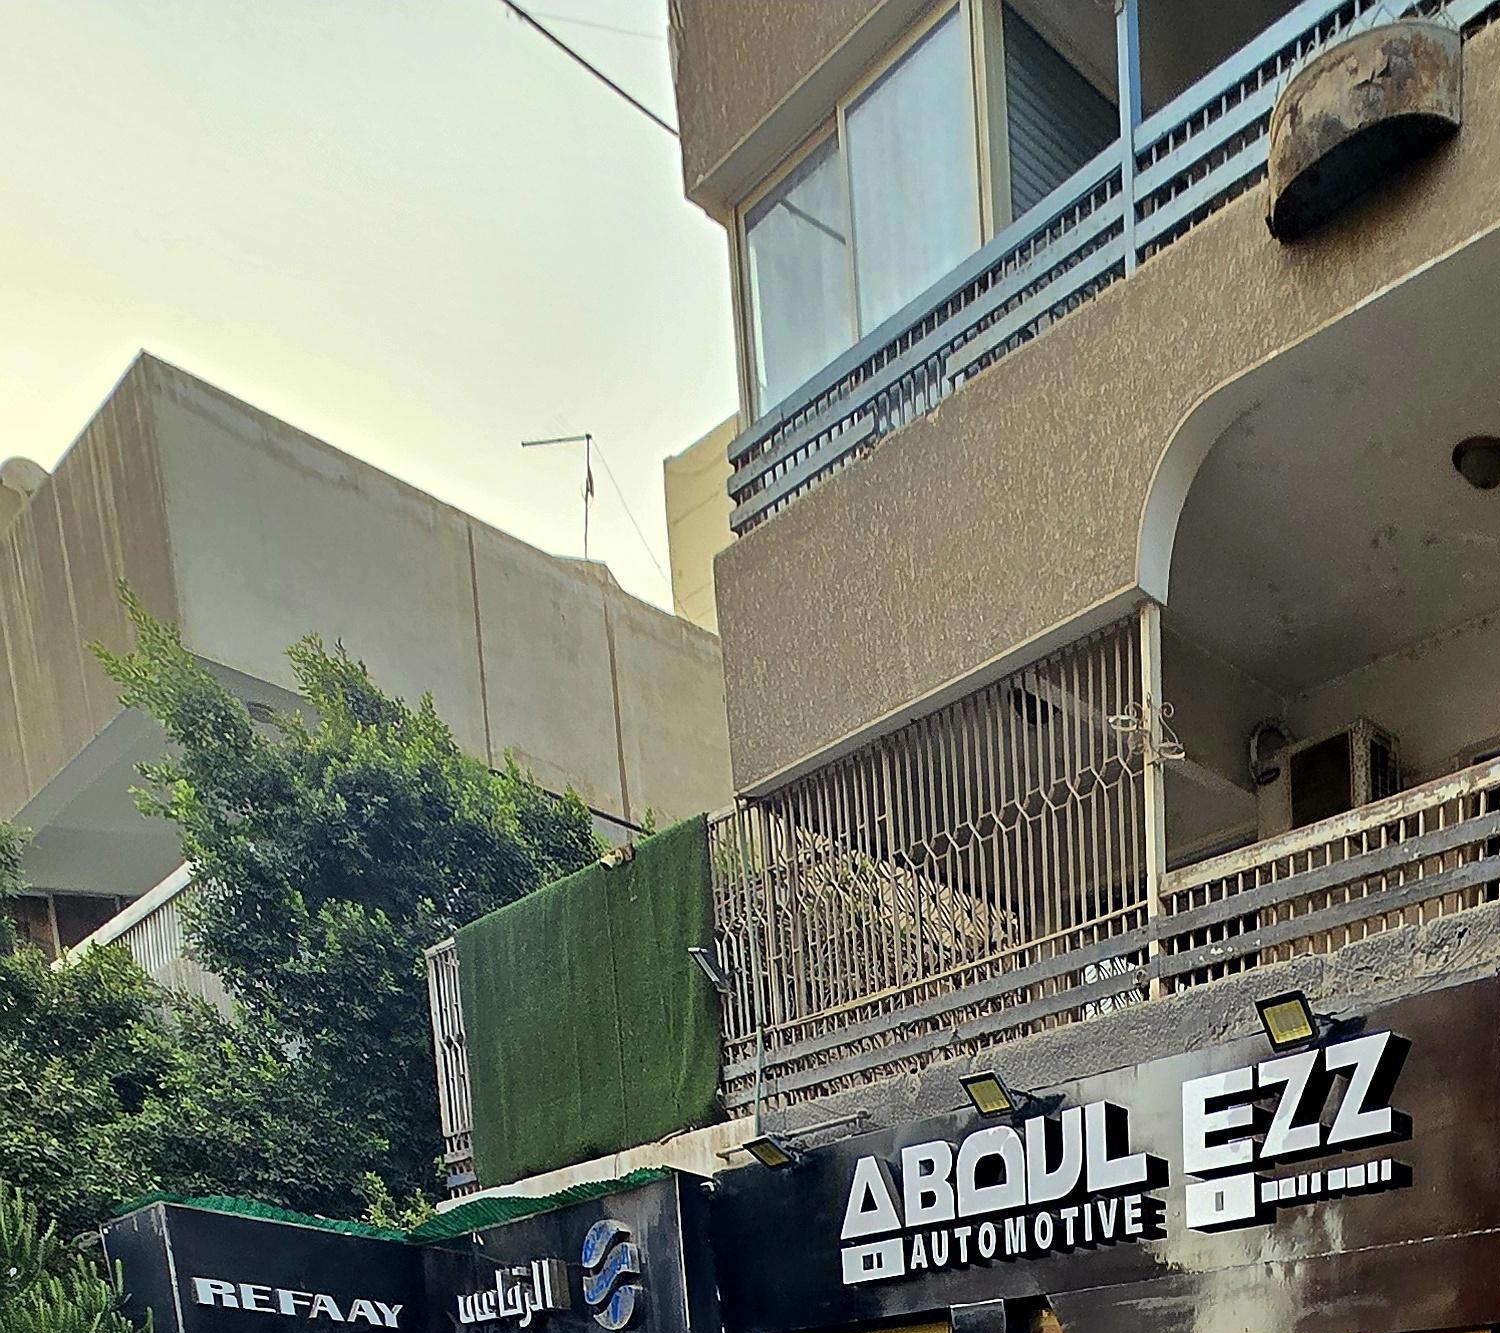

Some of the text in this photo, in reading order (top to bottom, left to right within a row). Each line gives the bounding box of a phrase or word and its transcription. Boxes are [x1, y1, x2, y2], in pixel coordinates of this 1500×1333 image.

[841, 1031, 1392, 1239] ABOUL EZZ
[911, 1194, 1144, 1270] AUTOMOTIVE
[193, 1277, 403, 1329] REFAAY
